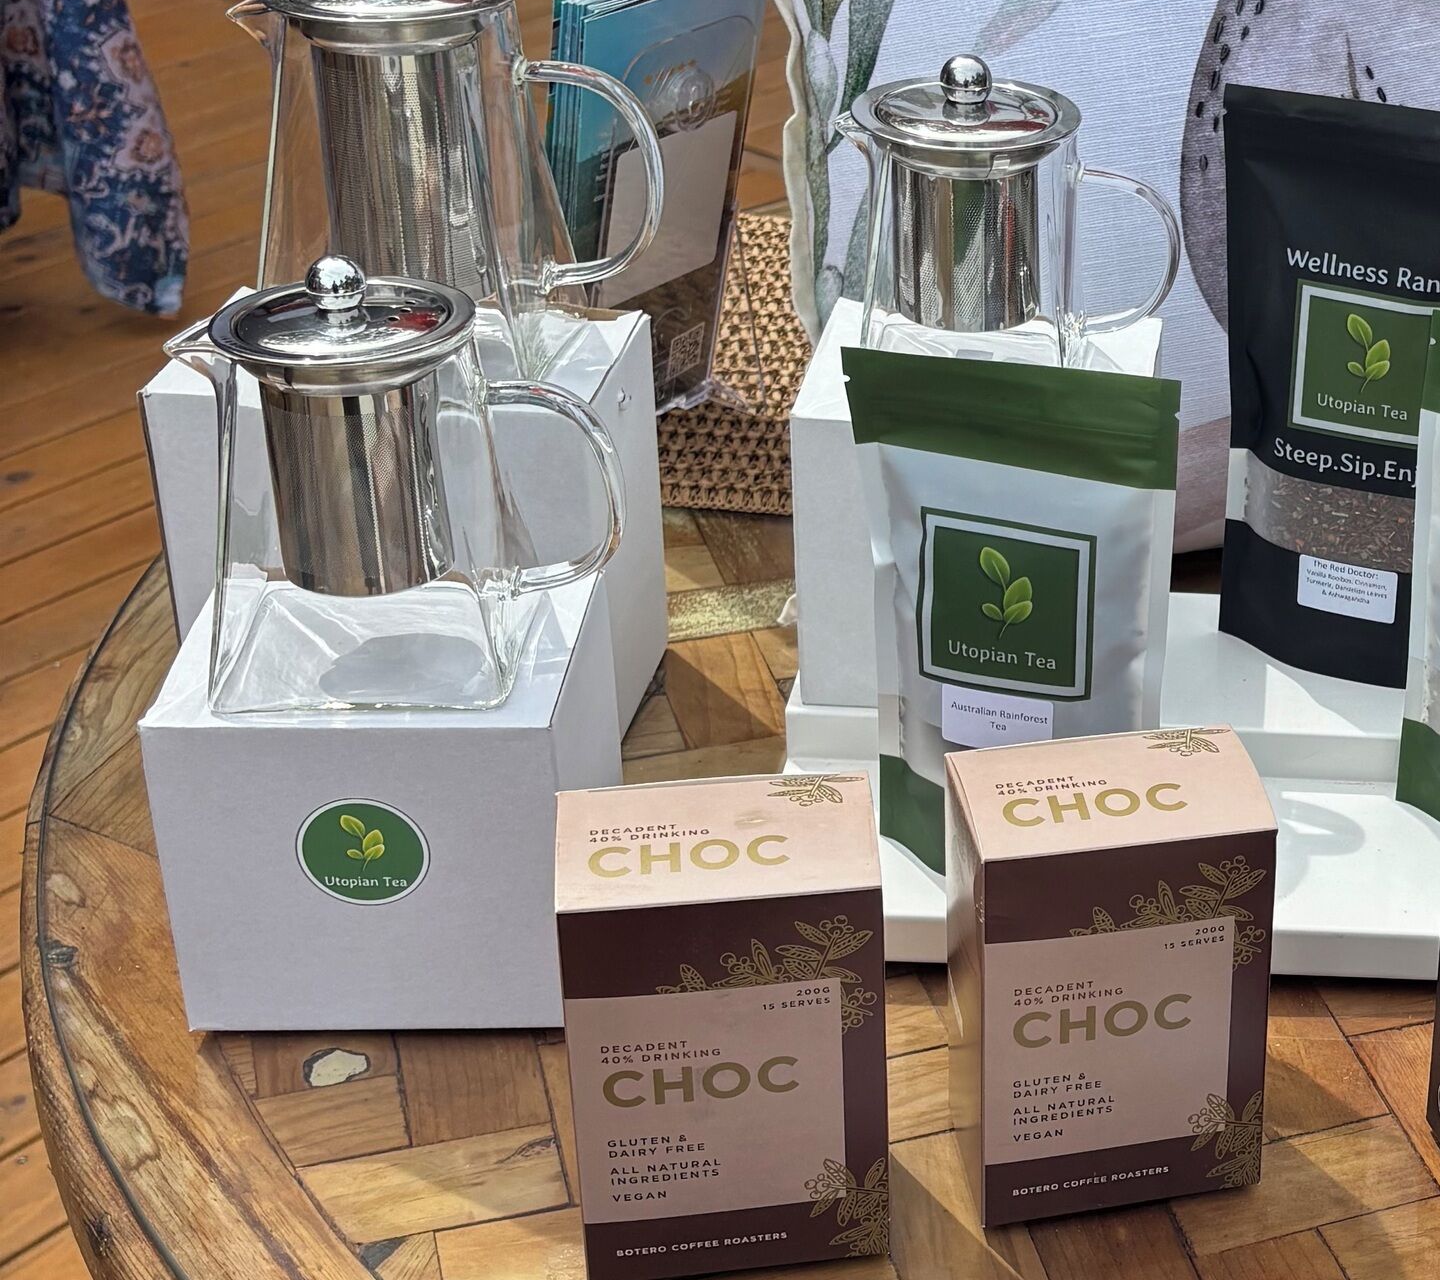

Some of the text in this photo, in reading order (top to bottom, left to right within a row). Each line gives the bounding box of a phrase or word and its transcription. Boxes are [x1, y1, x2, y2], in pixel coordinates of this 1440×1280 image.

[1287, 248, 1388, 285] Wellness
[1318, 393, 1407, 420] Utopian Tea
[1330, 563, 1346, 573] Red
[949, 640, 1056, 669] Utopian Tea
[951, 701, 1048, 724] Australian Rainforest
[990, 721, 1007, 731] Tea
[1002, 783, 1188, 827] CHOC
[590, 824, 676, 836] DECADENT
[630, 829, 709, 840] DRINKING
[588, 835, 790, 877] CHOC
[324, 876, 407, 888] Utopian Tea
[1014, 981, 1094, 997] DECADENT
[1014, 987, 1123, 1006] 40% DRINKING
[781, 997, 830, 1009] SERVES
[1013, 993, 1191, 1048] CHOC
[600, 1040, 687, 1054] DECADENT
[601, 1048, 720, 1064] 40% DRINKING
[602, 1056, 799, 1108] CHOC
[1013, 1072, 1086, 1088] GLUTEN &
[1013, 1080, 1101, 1099] DAIRY FREE
[1013, 1095, 1114, 1116] ALL NATURAL
[1013, 1105, 1112, 1126] INGREDIENTS
[607, 1134, 687, 1148] GLUTEN &
[1013, 1129, 1063, 1142] VEGAN
[609, 1143, 705, 1158] DAIRY FREE
[610, 1158, 721, 1175] ALL NATURAL
[611, 1168, 719, 1186] INGREDIENTS
[1012, 1166, 1169, 1196] BOTERO COFFEE ROASTERS
[612, 1191, 666, 1202] VEGAN
[616, 1232, 787, 1257] BOTERO COFFEE ROASTERS
